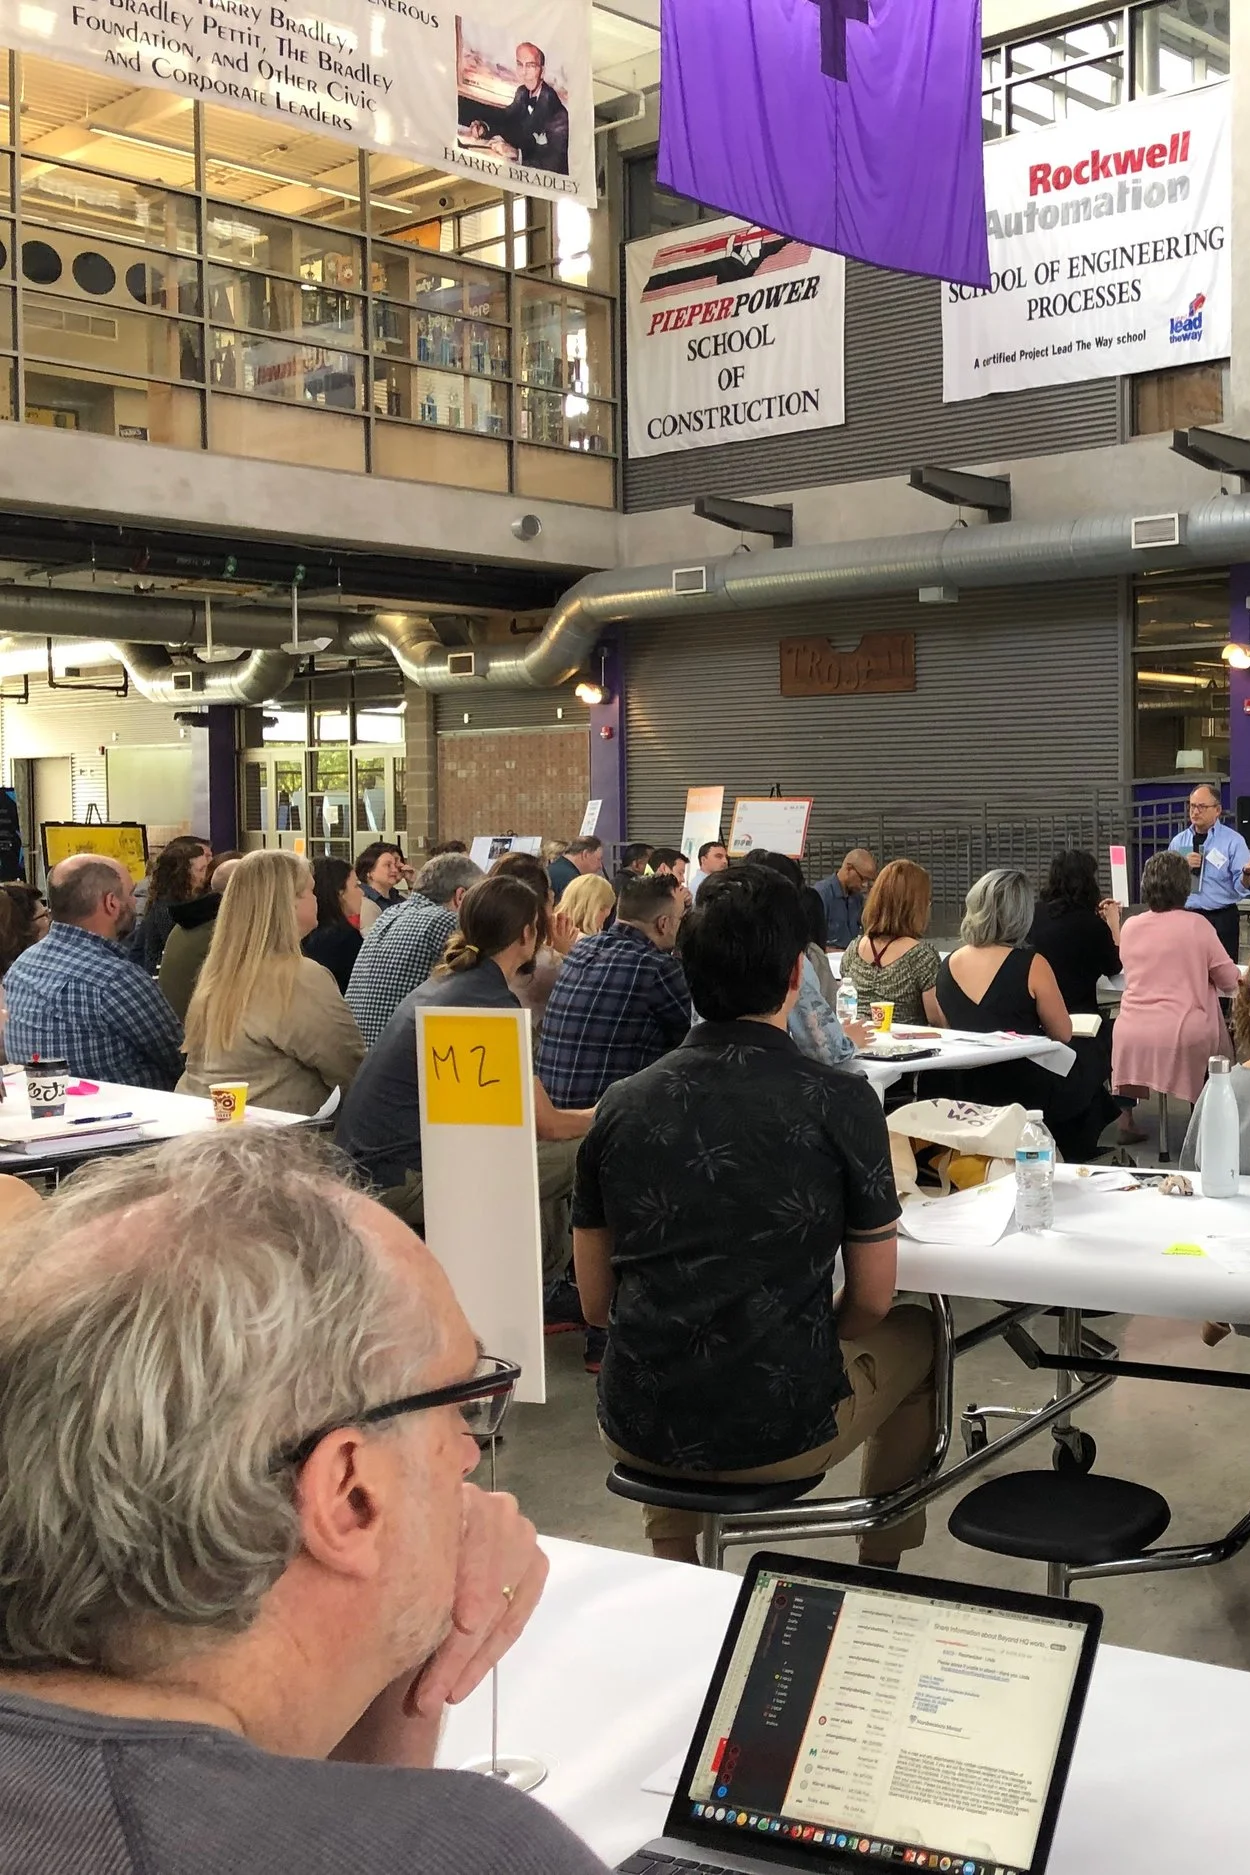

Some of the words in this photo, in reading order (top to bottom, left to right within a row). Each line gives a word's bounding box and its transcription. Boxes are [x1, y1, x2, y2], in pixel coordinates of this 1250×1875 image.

[199, 0, 263, 25] ARRY
[443, 147, 502, 176] HARRY
[508, 167, 580, 194] BRADLEY
[1029, 130, 1191, 196] Rockwell
[986, 175, 1191, 240] Automation
[1034, 260, 1060, 286] OF
[1067, 226, 1225, 279] ENGINEERING
[646, 275, 821, 336] PIEPERPOWER
[1026, 278, 1142, 321] PROCESSES
[687, 323, 776, 362] SCHOOL
[1169, 311, 1203, 335] lead
[973, 358, 980, 370] A
[1019, 346, 1049, 363] Project
[1052, 341, 1073, 356] Lead
[1075, 339, 1092, 352] The
[1095, 336, 1113, 351] Way
[1116, 329, 1147, 344] school
[717, 365, 745, 391] OF
[647, 388, 820, 440] CONSTRUCTION
